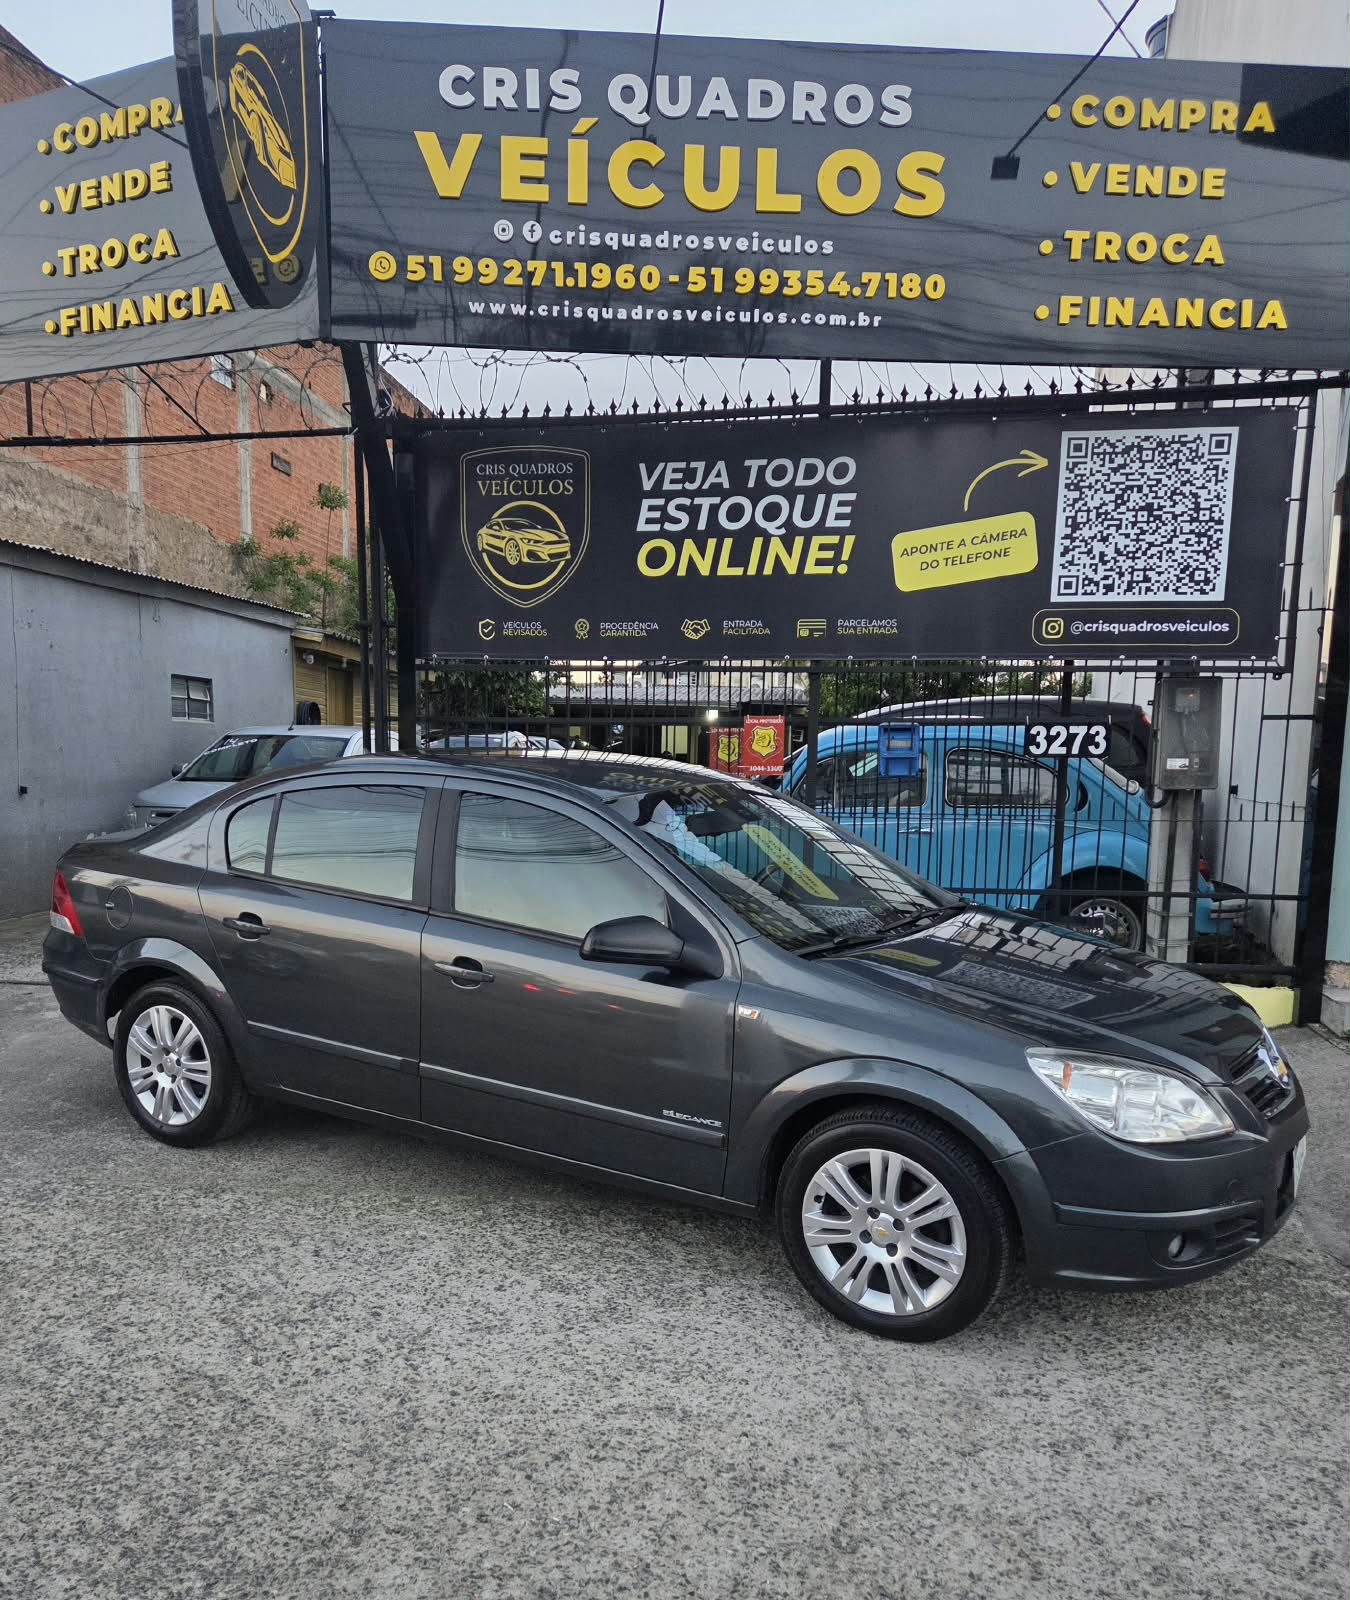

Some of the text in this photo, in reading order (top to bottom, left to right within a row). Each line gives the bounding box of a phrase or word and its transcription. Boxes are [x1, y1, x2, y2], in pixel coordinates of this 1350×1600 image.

[438, 64, 912, 127] CRIS QUADROS
[1070, 94, 1276, 133] COMPRA
[413, 117, 946, 217] VEÍCULOS
[1069, 161, 1226, 200] VENDE
[55, 160, 171, 214] VENDE
[57, 228, 179, 277] TROCA
[548, 224, 835, 255] crisquadrosveiculos
[1063, 229, 1225, 265] TROCA
[406, 254, 443, 282] 51
[452, 256, 662, 292] 99271.1960
[686, 266, 724, 294] 51
[734, 267, 946, 300] 99354.7180
[60, 282, 234, 336] FINANCIA
[468, 300, 883, 328] www.crisquadrosveiculos.com.br
[1057, 295, 1288, 330] FINANCIA
[476, 462, 574, 477] CRIS QUADROS
[638, 456, 857, 491] VEJA TODO
[477, 477, 574, 496] VEÍCULOS
[636, 492, 857, 536] ESTOQUE
[636, 534, 857, 577] ONLINE!
[900, 527, 1029, 558] APONTE A CÂMERA
[920, 547, 1011, 571] DO TELEFONE
[502, 620, 542, 629] VEÍCULOS
[502, 628, 548, 637] REVISADOS
[600, 620, 659, 630] PROCEDÊNCIA
[600, 629, 648, 637] GARANTIDA
[723, 620, 763, 628] ENTRADA
[723, 627, 771, 635] FACILITADA
[837, 619, 898, 627] PARCELAMOS
[837, 627, 855, 635] SUA
[1070, 620, 1230, 635] @crisquadrosveiculos
[1028, 725, 1107, 756] 3273
